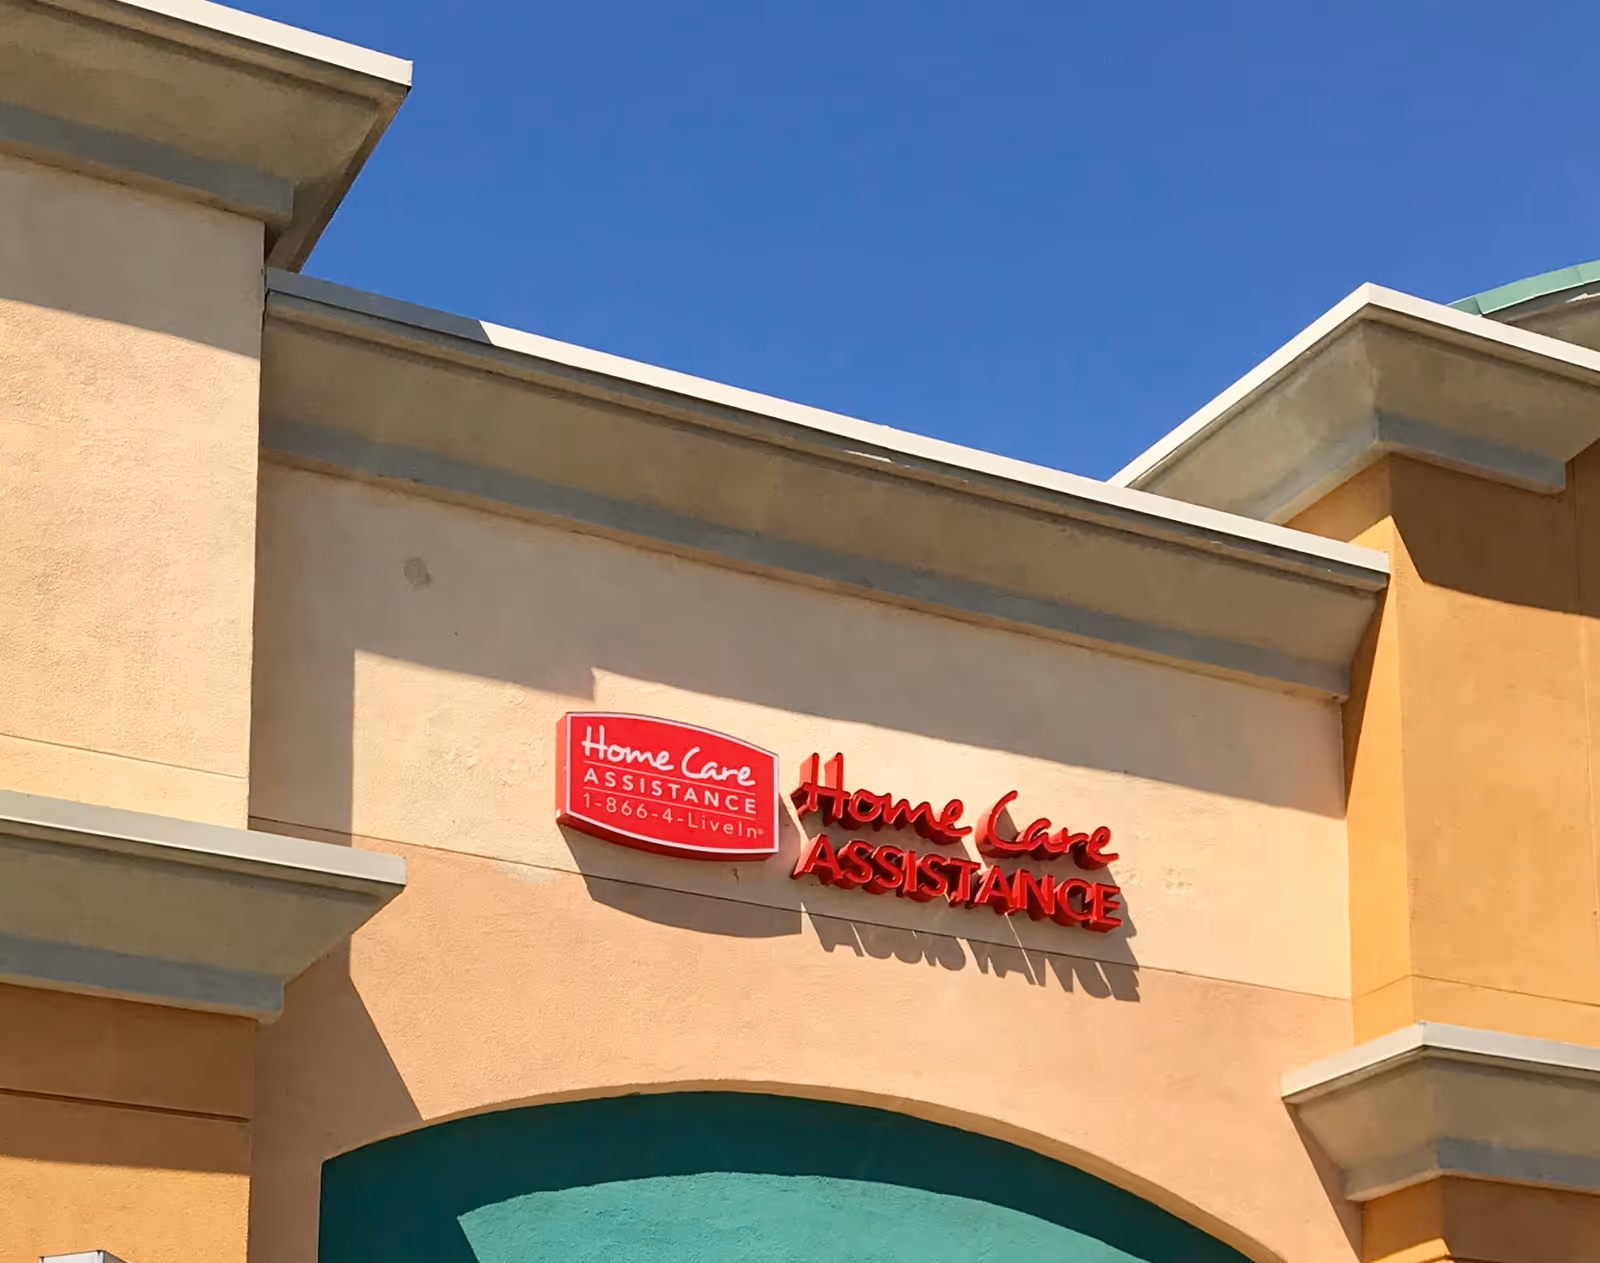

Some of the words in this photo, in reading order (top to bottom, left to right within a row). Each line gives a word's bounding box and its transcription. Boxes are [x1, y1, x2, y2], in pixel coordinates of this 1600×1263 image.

[581, 725, 674, 771] Home
[681, 747, 756, 786] Care
[583, 767, 757, 815] ASSISTANCE
[790, 752, 973, 843] Home
[975, 790, 1119, 868] Care
[790, 833, 1123, 932] ASSISTANCE
